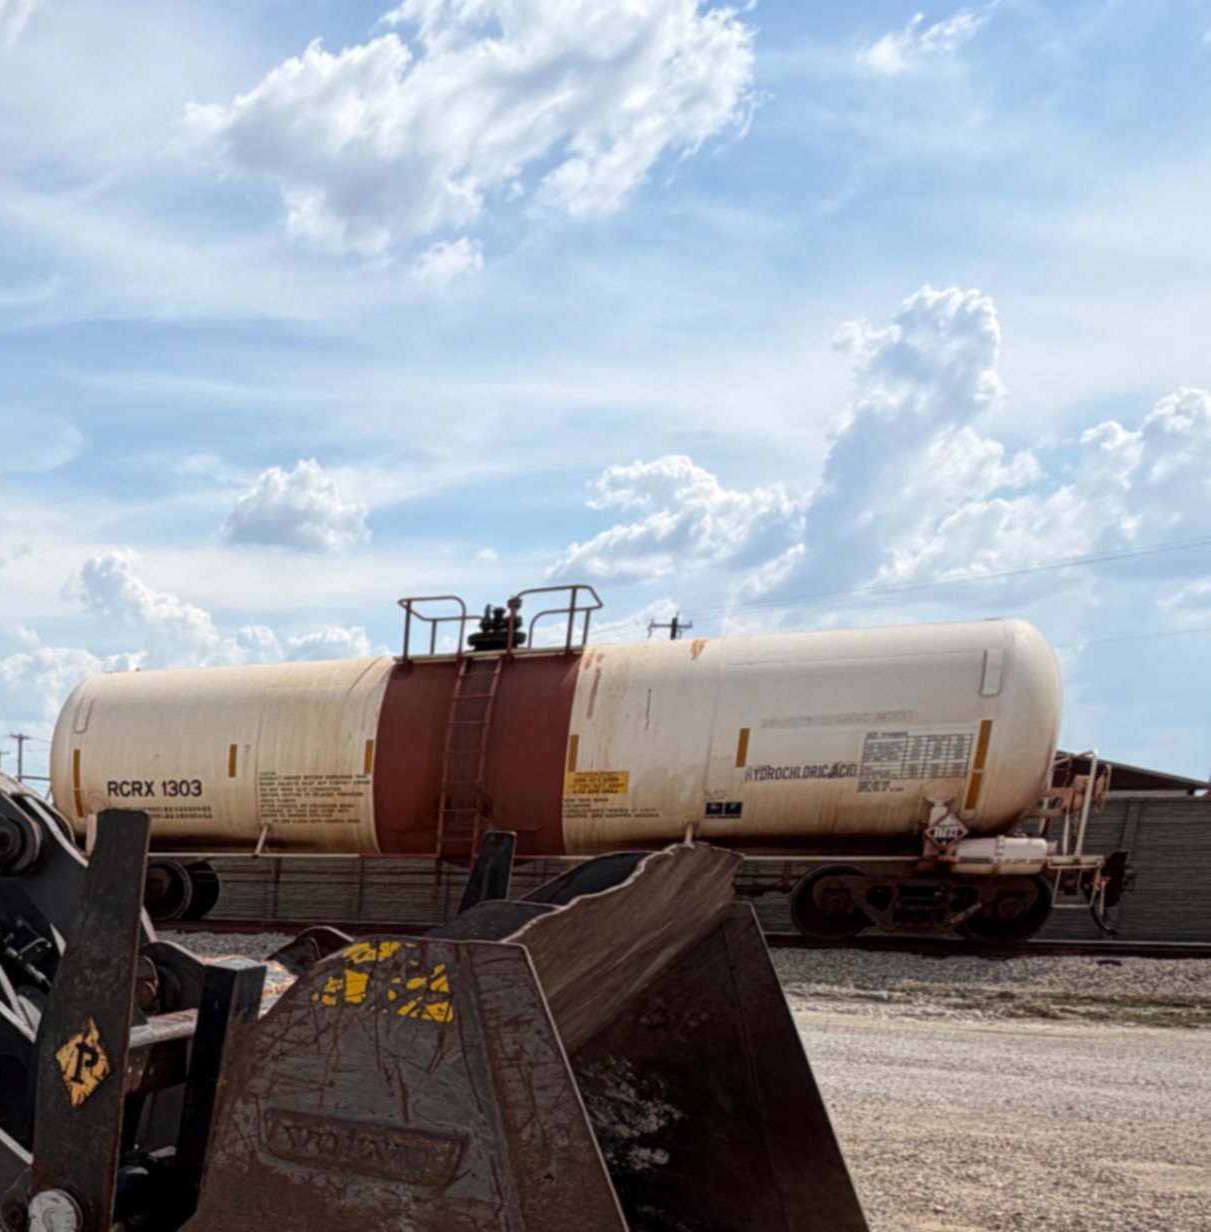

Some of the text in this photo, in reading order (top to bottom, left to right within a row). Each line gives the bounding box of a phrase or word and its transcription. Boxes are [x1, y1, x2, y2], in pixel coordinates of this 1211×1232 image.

[745, 762, 857, 781] HYDROCHLORIC ACID
[107, 779, 202, 797] RCRX 1303
[71, 1043, 99, 1084] P
